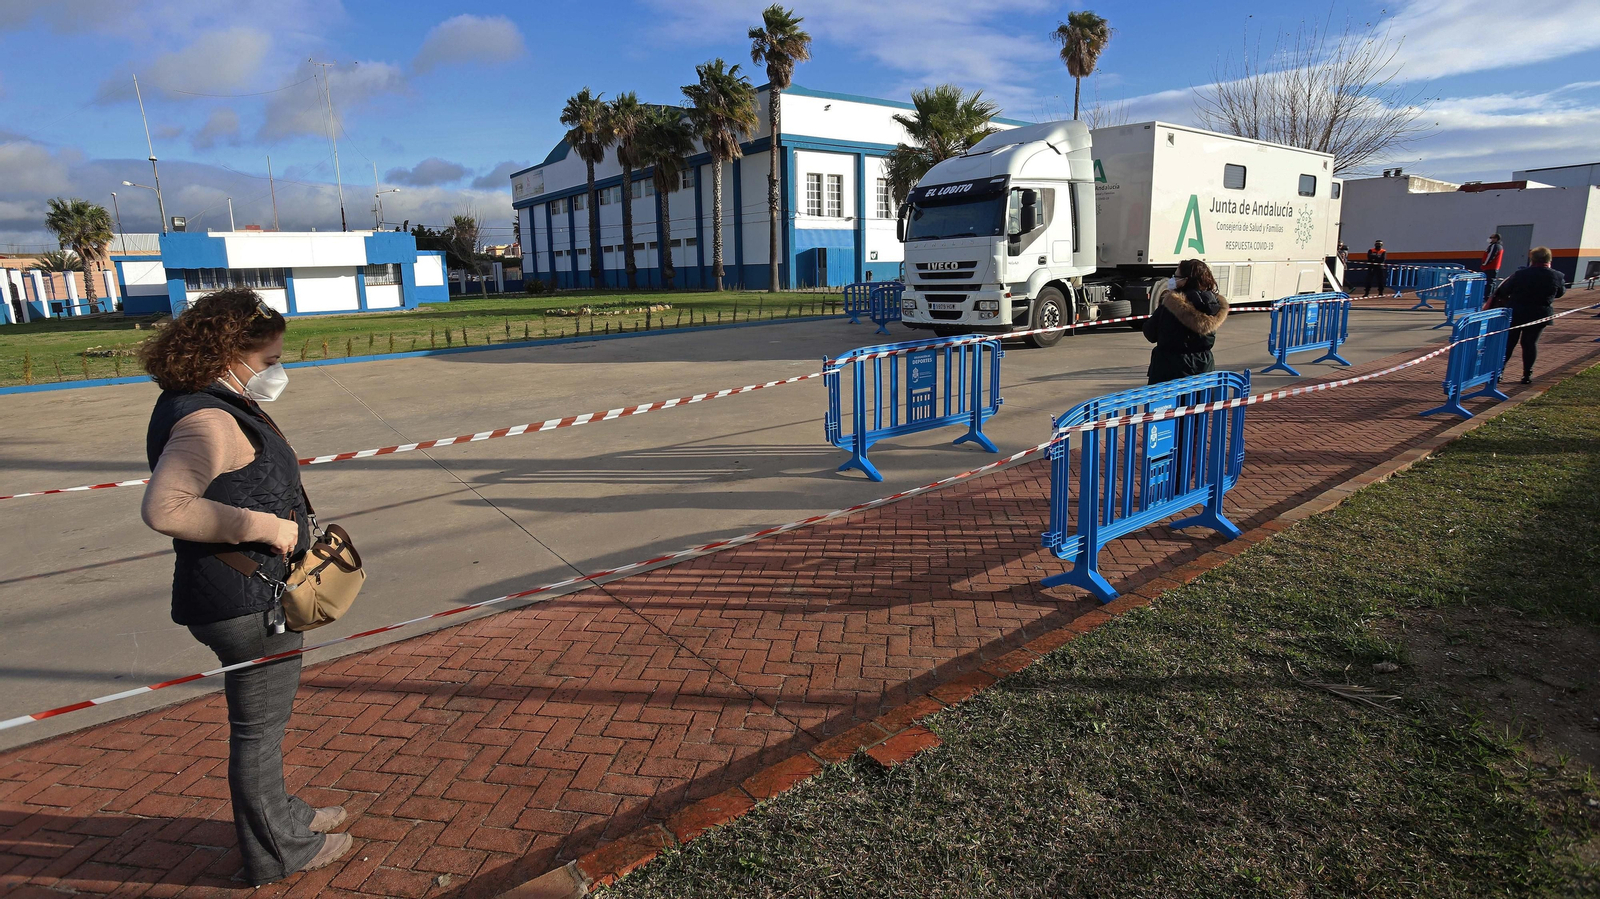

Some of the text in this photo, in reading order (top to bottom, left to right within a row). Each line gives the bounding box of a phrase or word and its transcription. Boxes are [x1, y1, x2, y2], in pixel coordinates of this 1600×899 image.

[925, 183, 973, 198] EL LOBITO
[1209, 196, 1293, 217] Junta de Andalucía
[1216, 221, 1284, 234] Consejería de Salud y Familias
[1225, 240, 1274, 251] RESPUESTA COVID-19
[927, 261, 959, 271] IVECO
